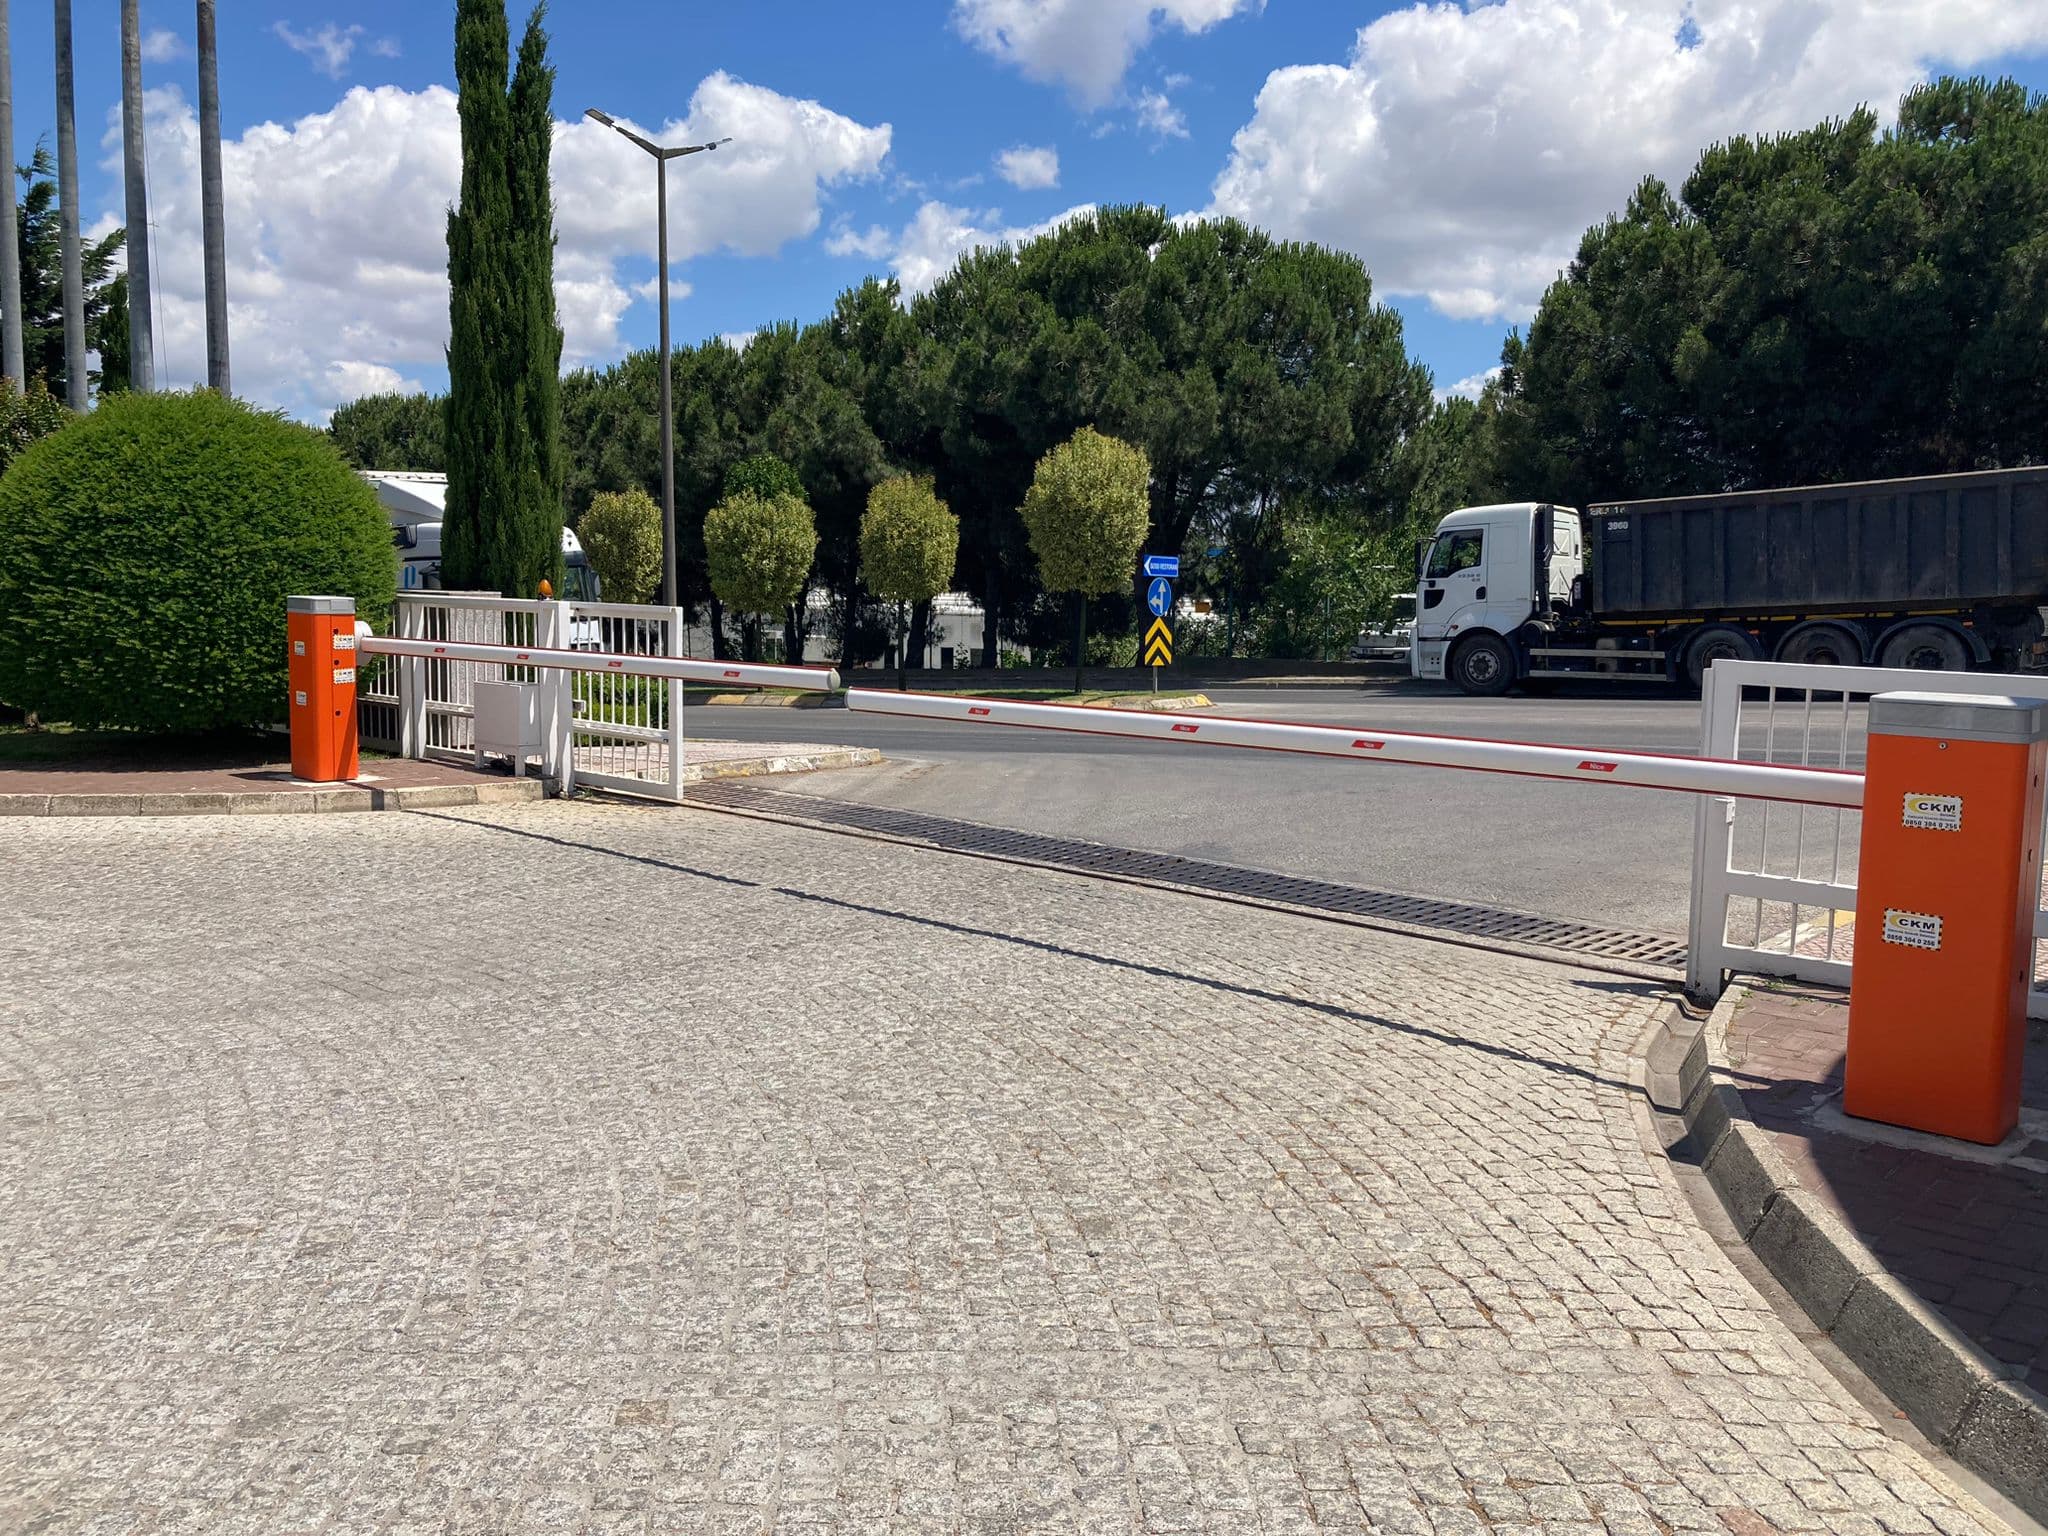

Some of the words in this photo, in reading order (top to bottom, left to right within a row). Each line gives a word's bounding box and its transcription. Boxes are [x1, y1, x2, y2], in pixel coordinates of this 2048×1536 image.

[1590, 762, 1605, 770] Nice
[1918, 802, 1956, 813] CKM
[1898, 918, 1935, 930] CKM
